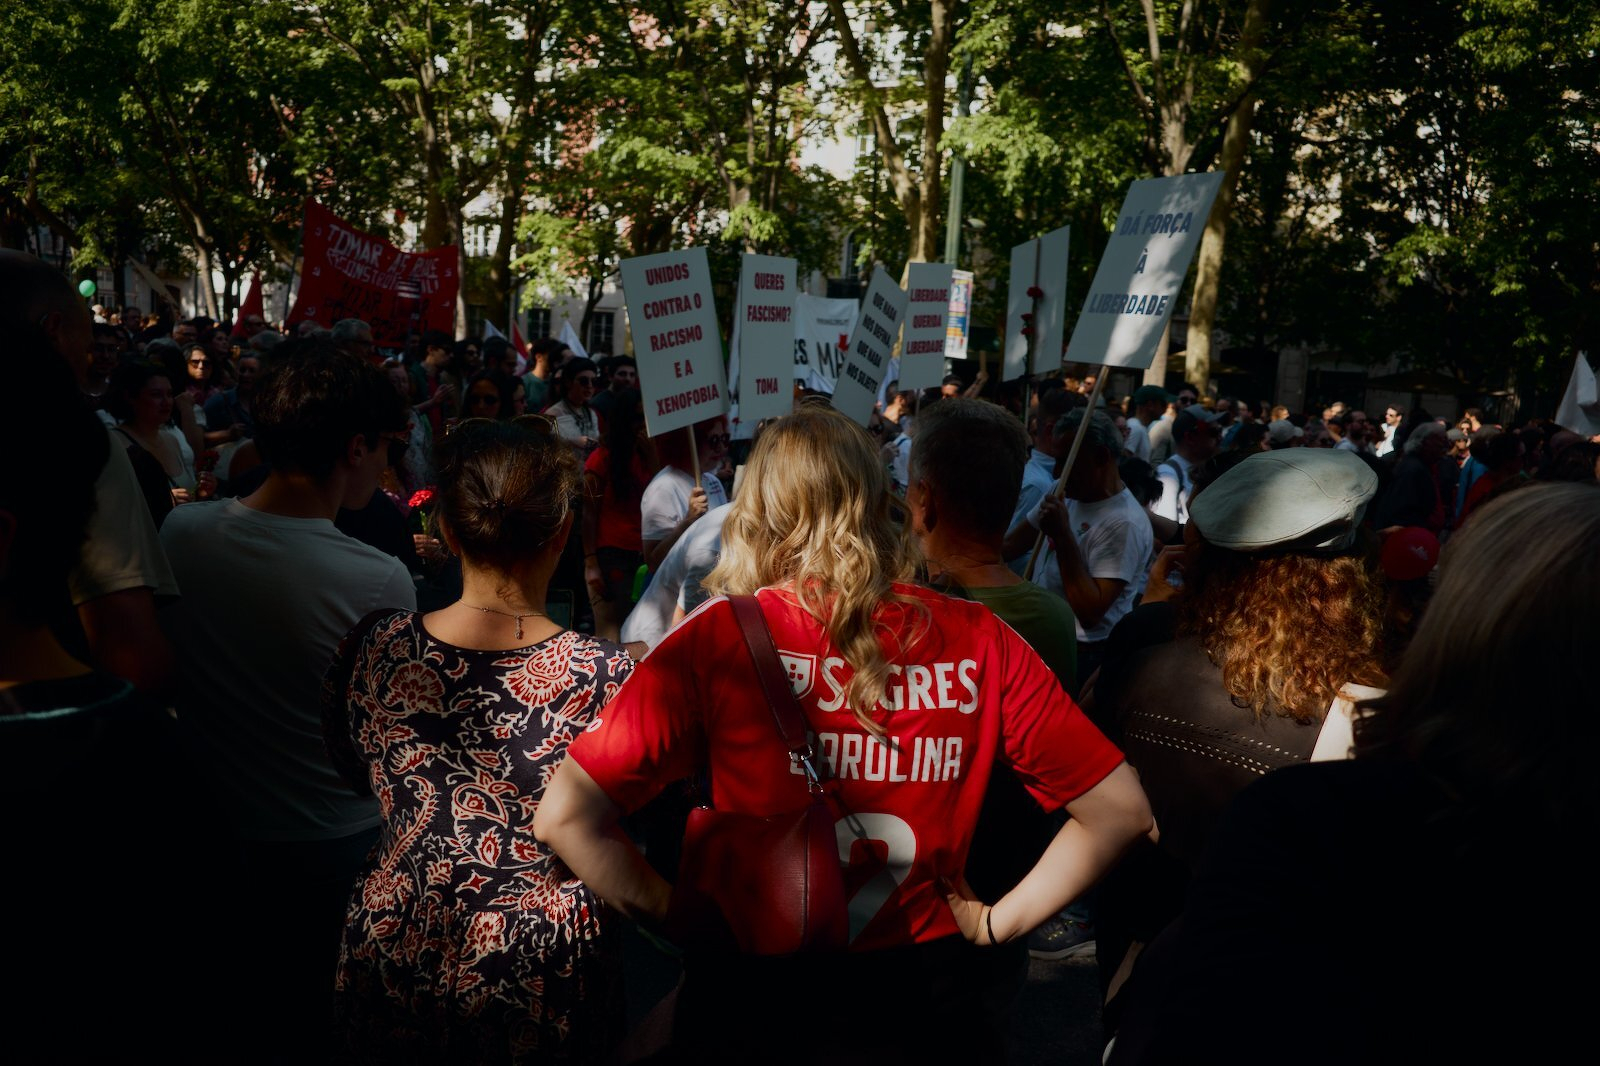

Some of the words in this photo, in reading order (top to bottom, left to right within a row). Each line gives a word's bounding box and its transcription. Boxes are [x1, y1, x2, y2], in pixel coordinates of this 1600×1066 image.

[1119, 210, 1145, 236] DÁ
[1142, 212, 1193, 238] FORÇA
[1133, 248, 1148, 274] À
[645, 263, 690, 286] UNIDOS
[754, 272, 785, 291] QUERES
[643, 295, 692, 320] CONTRA
[694, 293, 702, 309] O
[747, 304, 791, 322] FASCISMO?
[872, 291, 885, 311] QUE
[882, 300, 898, 322] NADA
[1087, 293, 1169, 316] LIBERDADE
[862, 313, 875, 333] NOS
[912, 314, 942, 329] QUERIDA
[650, 325, 703, 352] RACISMO
[906, 339, 944, 355] LIBERDADE
[856, 340, 869, 358] QUE
[867, 347, 883, 368] NADA
[674, 361, 682, 378] E
[684, 359, 694, 376] A
[846, 361, 859, 381] NOS
[857, 370, 879, 395] SUJEITE
[755, 377, 778, 395] TOMA
[656, 384, 720, 416] XENOFOBIA
[816, 656, 979, 715] SGRES
